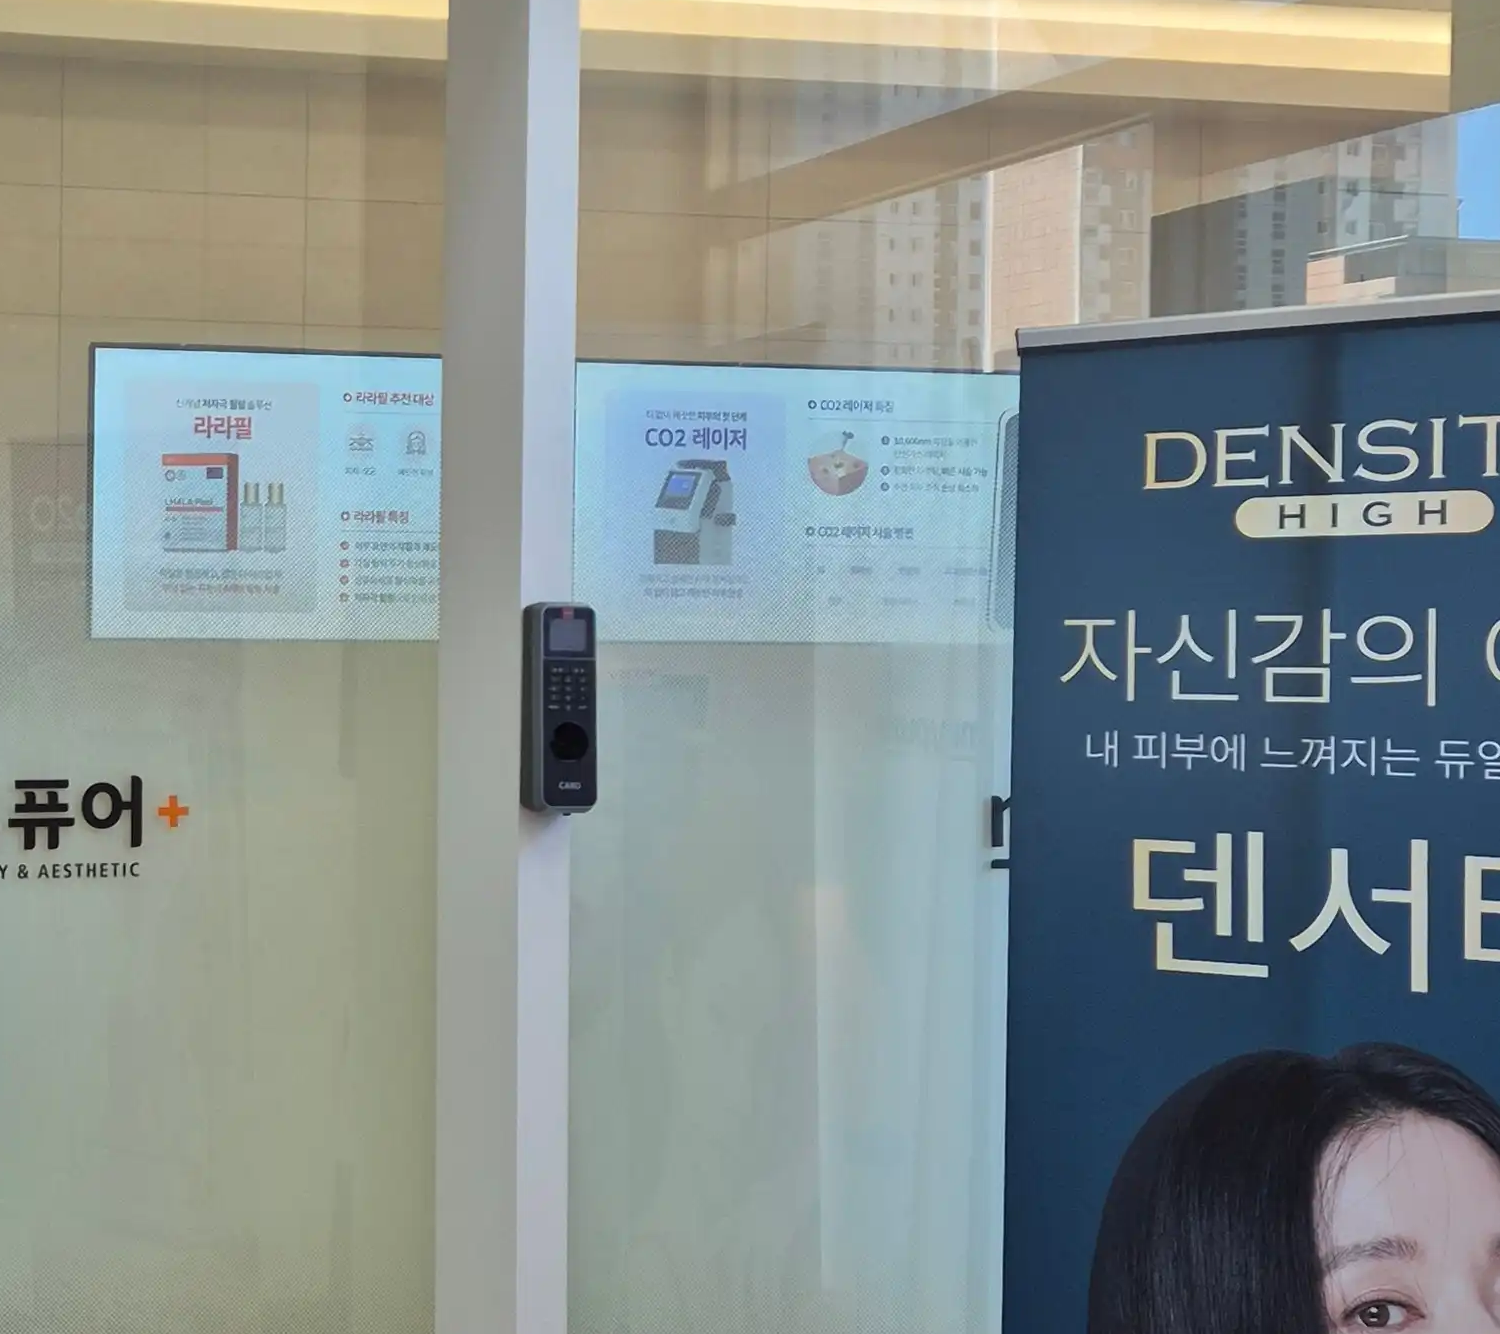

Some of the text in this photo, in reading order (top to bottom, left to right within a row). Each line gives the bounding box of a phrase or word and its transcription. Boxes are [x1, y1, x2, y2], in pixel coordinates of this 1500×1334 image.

[193, 415, 253, 440] 라라필
[645, 427, 748, 450] CO2 레이저
[1278, 499, 1449, 530] HIGH
[1059, 608, 1438, 706] 자신감의
[1086, 730, 1120, 768] 내
[1132, 730, 1246, 772] 피부에
[1260, 735, 1421, 778] 느껴지는
[17, 864, 29, 880] &
[37, 862, 141, 880] AESTHETIC
